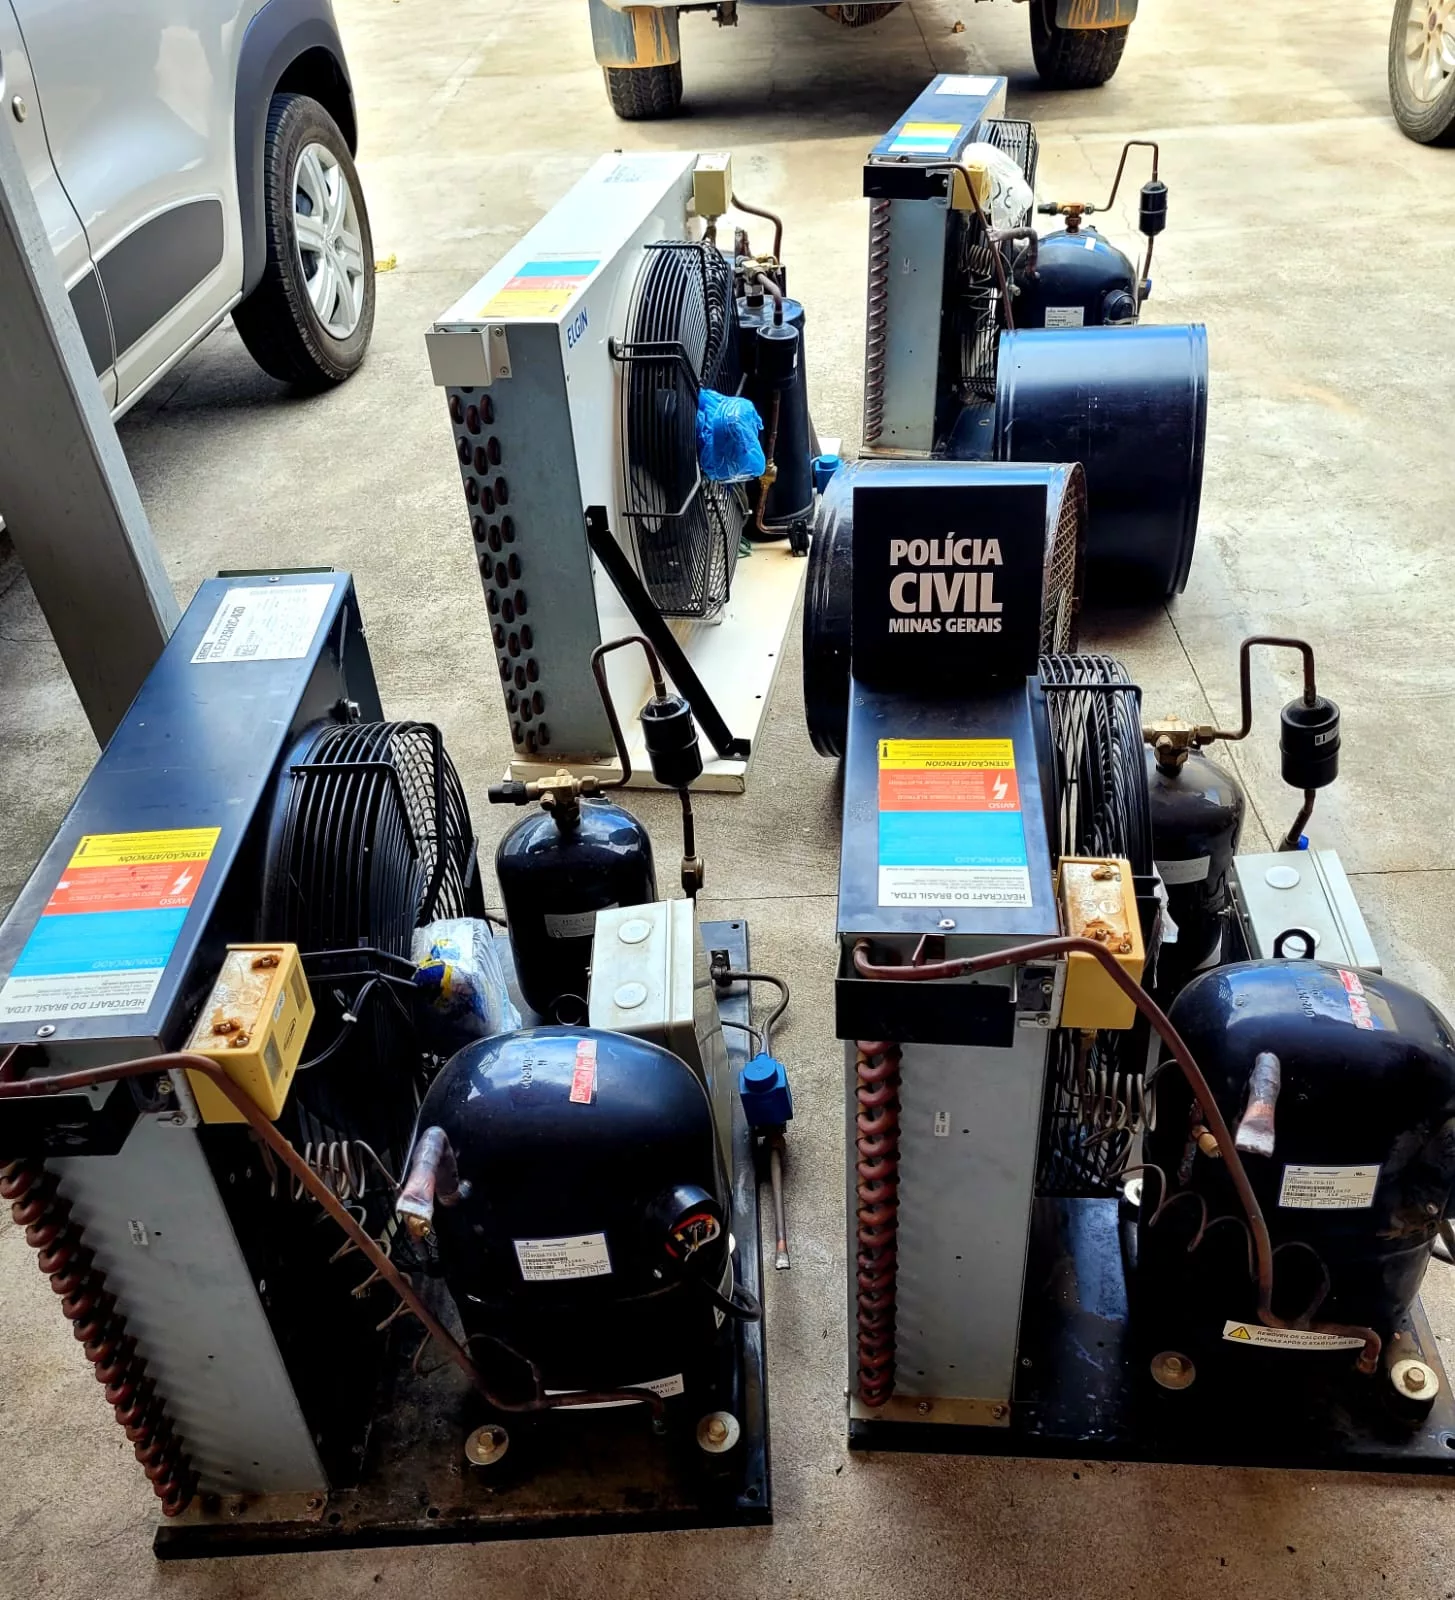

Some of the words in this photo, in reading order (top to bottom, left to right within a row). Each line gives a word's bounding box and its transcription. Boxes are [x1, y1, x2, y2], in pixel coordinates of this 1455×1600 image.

[567, 306, 588, 349] ELGIN
[889, 531, 1004, 566] POLÍCIA
[889, 572, 1004, 613] CIVIL
[888, 618, 942, 633] MINAS
[945, 618, 1002, 633] GERAIS
[891, 891, 918, 899] LTDA.
[921, 892, 952, 900] BRASIL
[954, 892, 969, 900] DO
[972, 892, 1026, 901] HEATCRAFT
[159, 897, 188, 906] AVISO
[5, 1004, 33, 1014] LTDA.
[33, 1002, 68, 1012] BRASIL
[71, 1001, 87, 1010] DO
[89, 998, 146, 1010] HEATCRAFT
